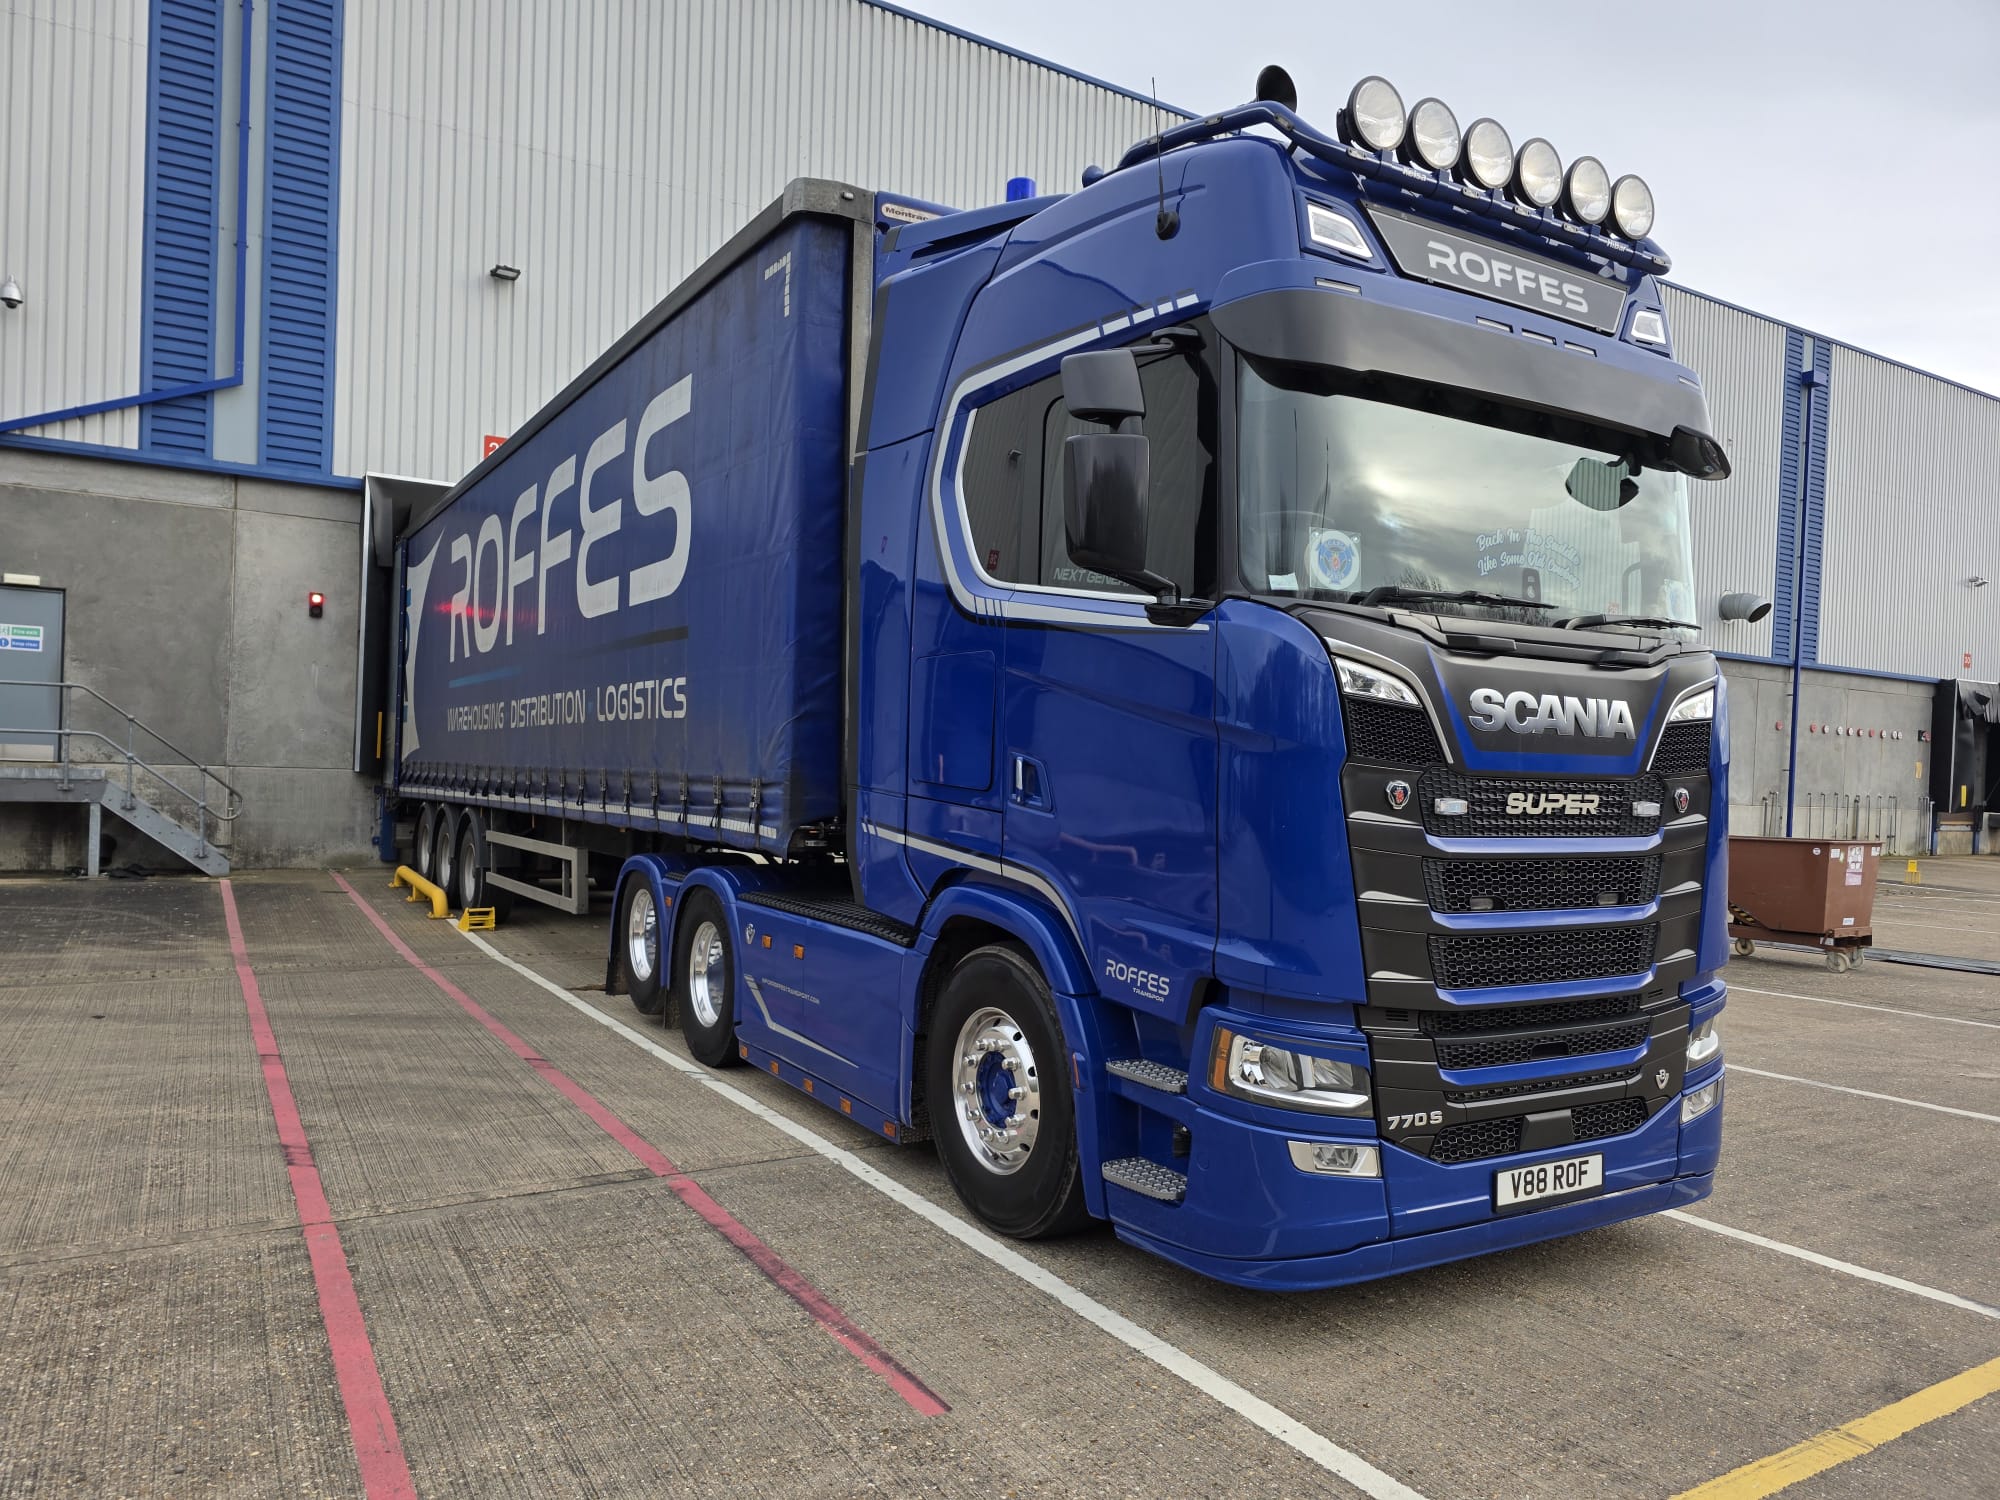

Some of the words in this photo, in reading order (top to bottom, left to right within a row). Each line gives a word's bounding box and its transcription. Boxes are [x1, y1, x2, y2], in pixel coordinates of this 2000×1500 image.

[885, 206, 929, 221] Montrac
[1427, 240, 1589, 313] ROFFES
[450, 373, 692, 663] ROFFES
[1476, 529, 1505, 552] Back
[1506, 528, 1521, 544] In
[1523, 528, 1544, 547] The
[1053, 567, 1087, 582] NEXT
[1477, 556, 1498, 577] Like
[1500, 552, 1525, 567] Some
[447, 702, 504, 732] WAREHOUSING
[510, 689, 586, 728] DISTRIBUTION
[597, 677, 687, 721] LOGISTICS
[1468, 688, 1637, 740] SCANIA
[1506, 792, 1600, 815] SUPER
[1105, 959, 1170, 996] ROFFES
[1510, 1169, 1547, 1199] V88
[1553, 1160, 1590, 1192] ROF
